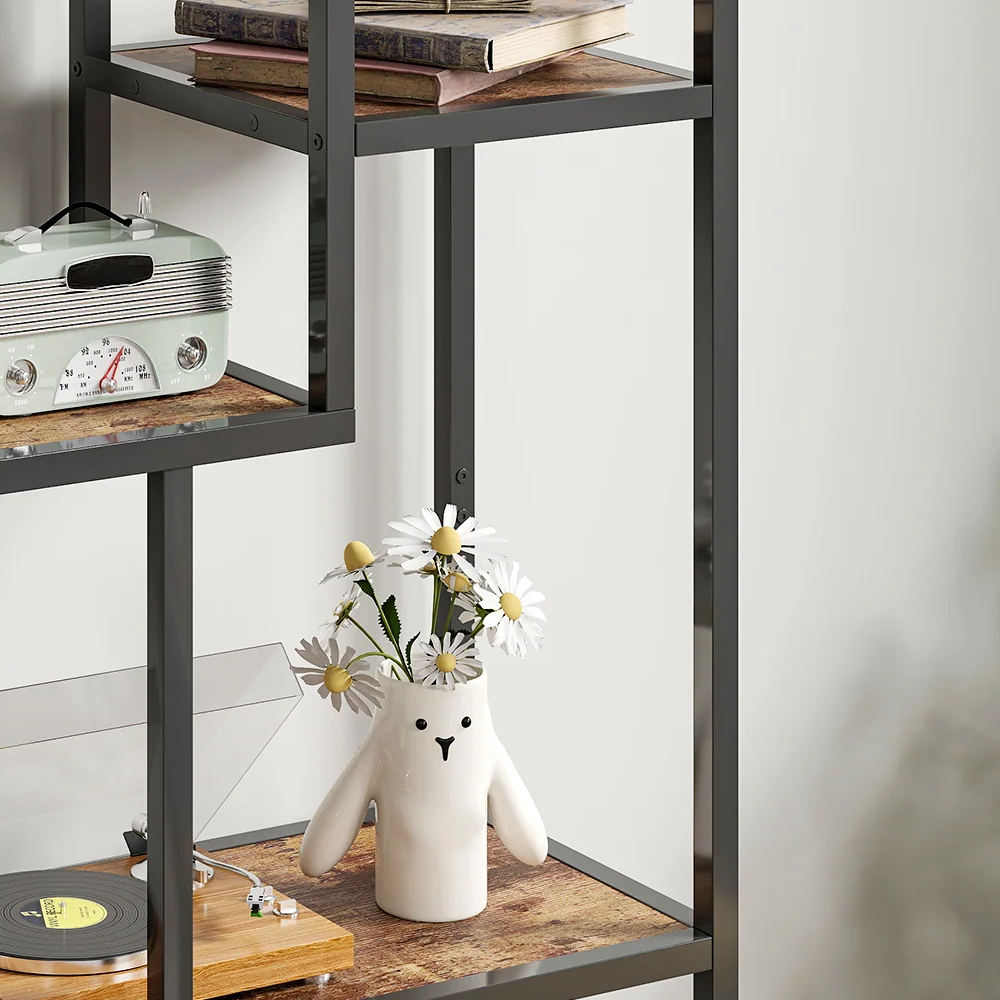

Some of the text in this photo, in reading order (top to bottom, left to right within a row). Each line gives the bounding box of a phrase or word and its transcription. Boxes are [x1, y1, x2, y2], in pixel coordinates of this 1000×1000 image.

[102, 338, 111, 347] 96
[81, 346, 90, 356] 92
[135, 364, 147, 374] 108
